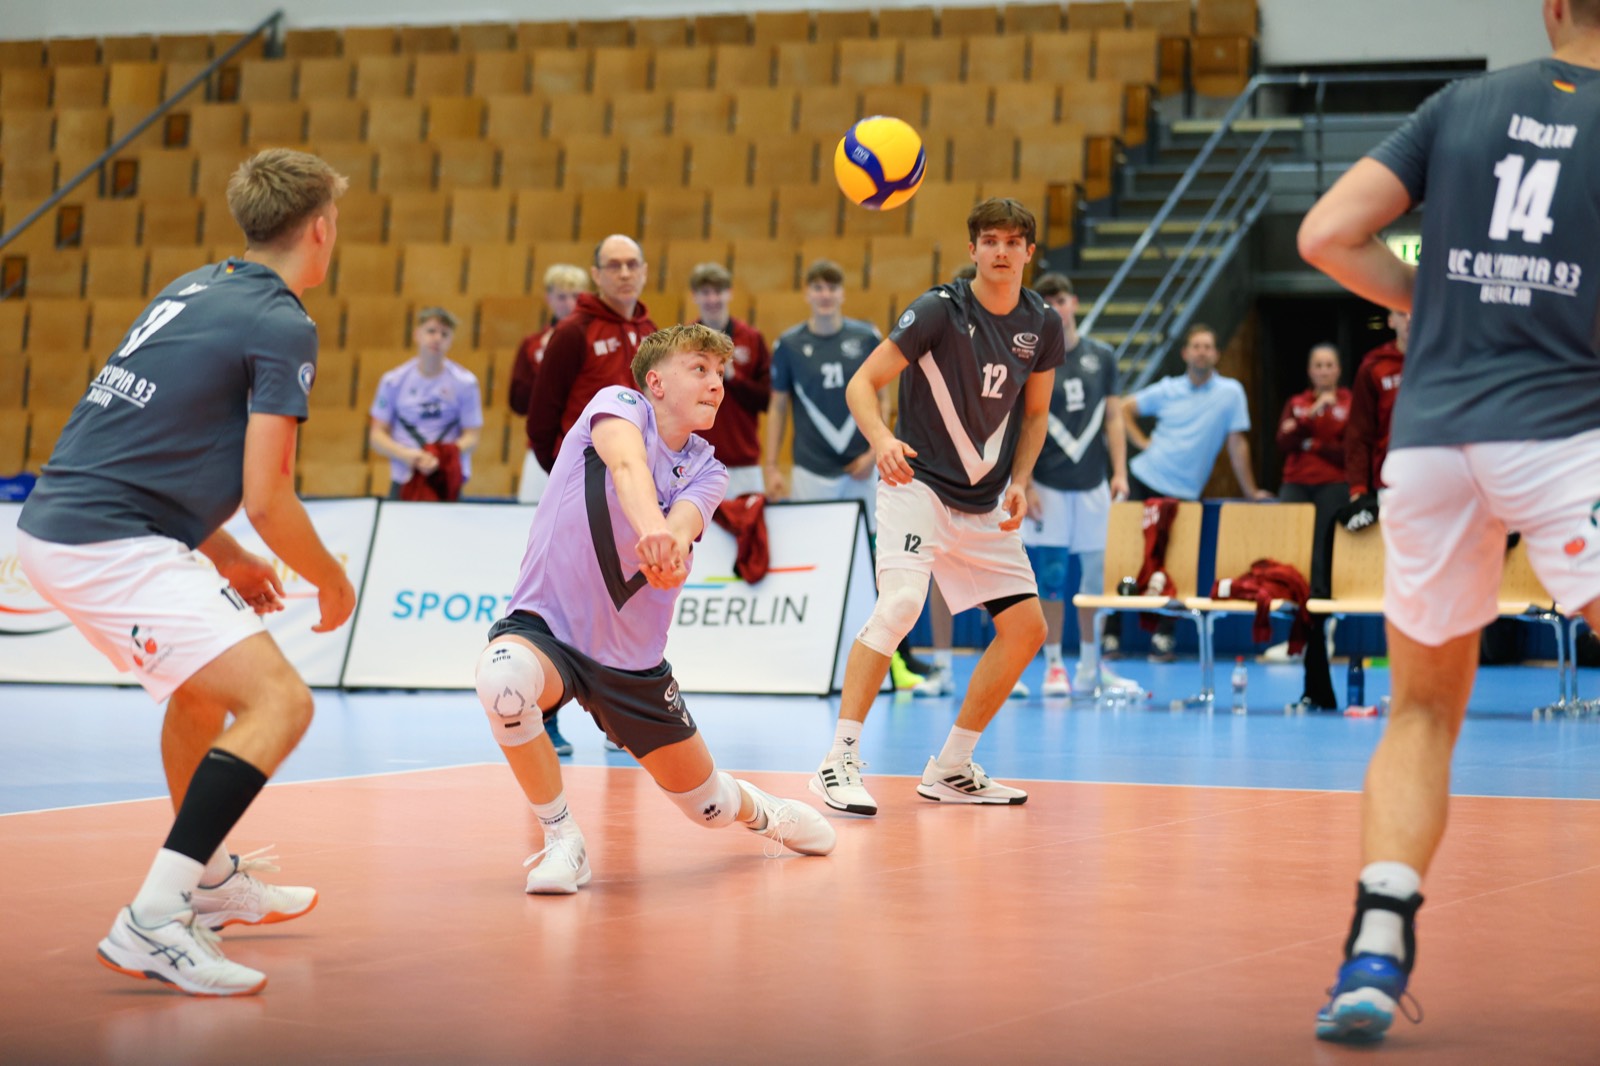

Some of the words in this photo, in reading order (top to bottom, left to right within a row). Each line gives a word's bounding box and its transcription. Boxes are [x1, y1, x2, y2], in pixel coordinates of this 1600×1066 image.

[1488, 153, 1561, 244] 14
[1473, 252, 1551, 284] OLYMPIA
[1554, 261, 1582, 290] 93
[131, 376, 157, 403] 93
[821, 362, 844, 389] 21
[981, 362, 1008, 399] 12
[904, 533, 922, 555] 12
[392, 590, 512, 622] SPOR
[677, 593, 808, 626] BERLIN
